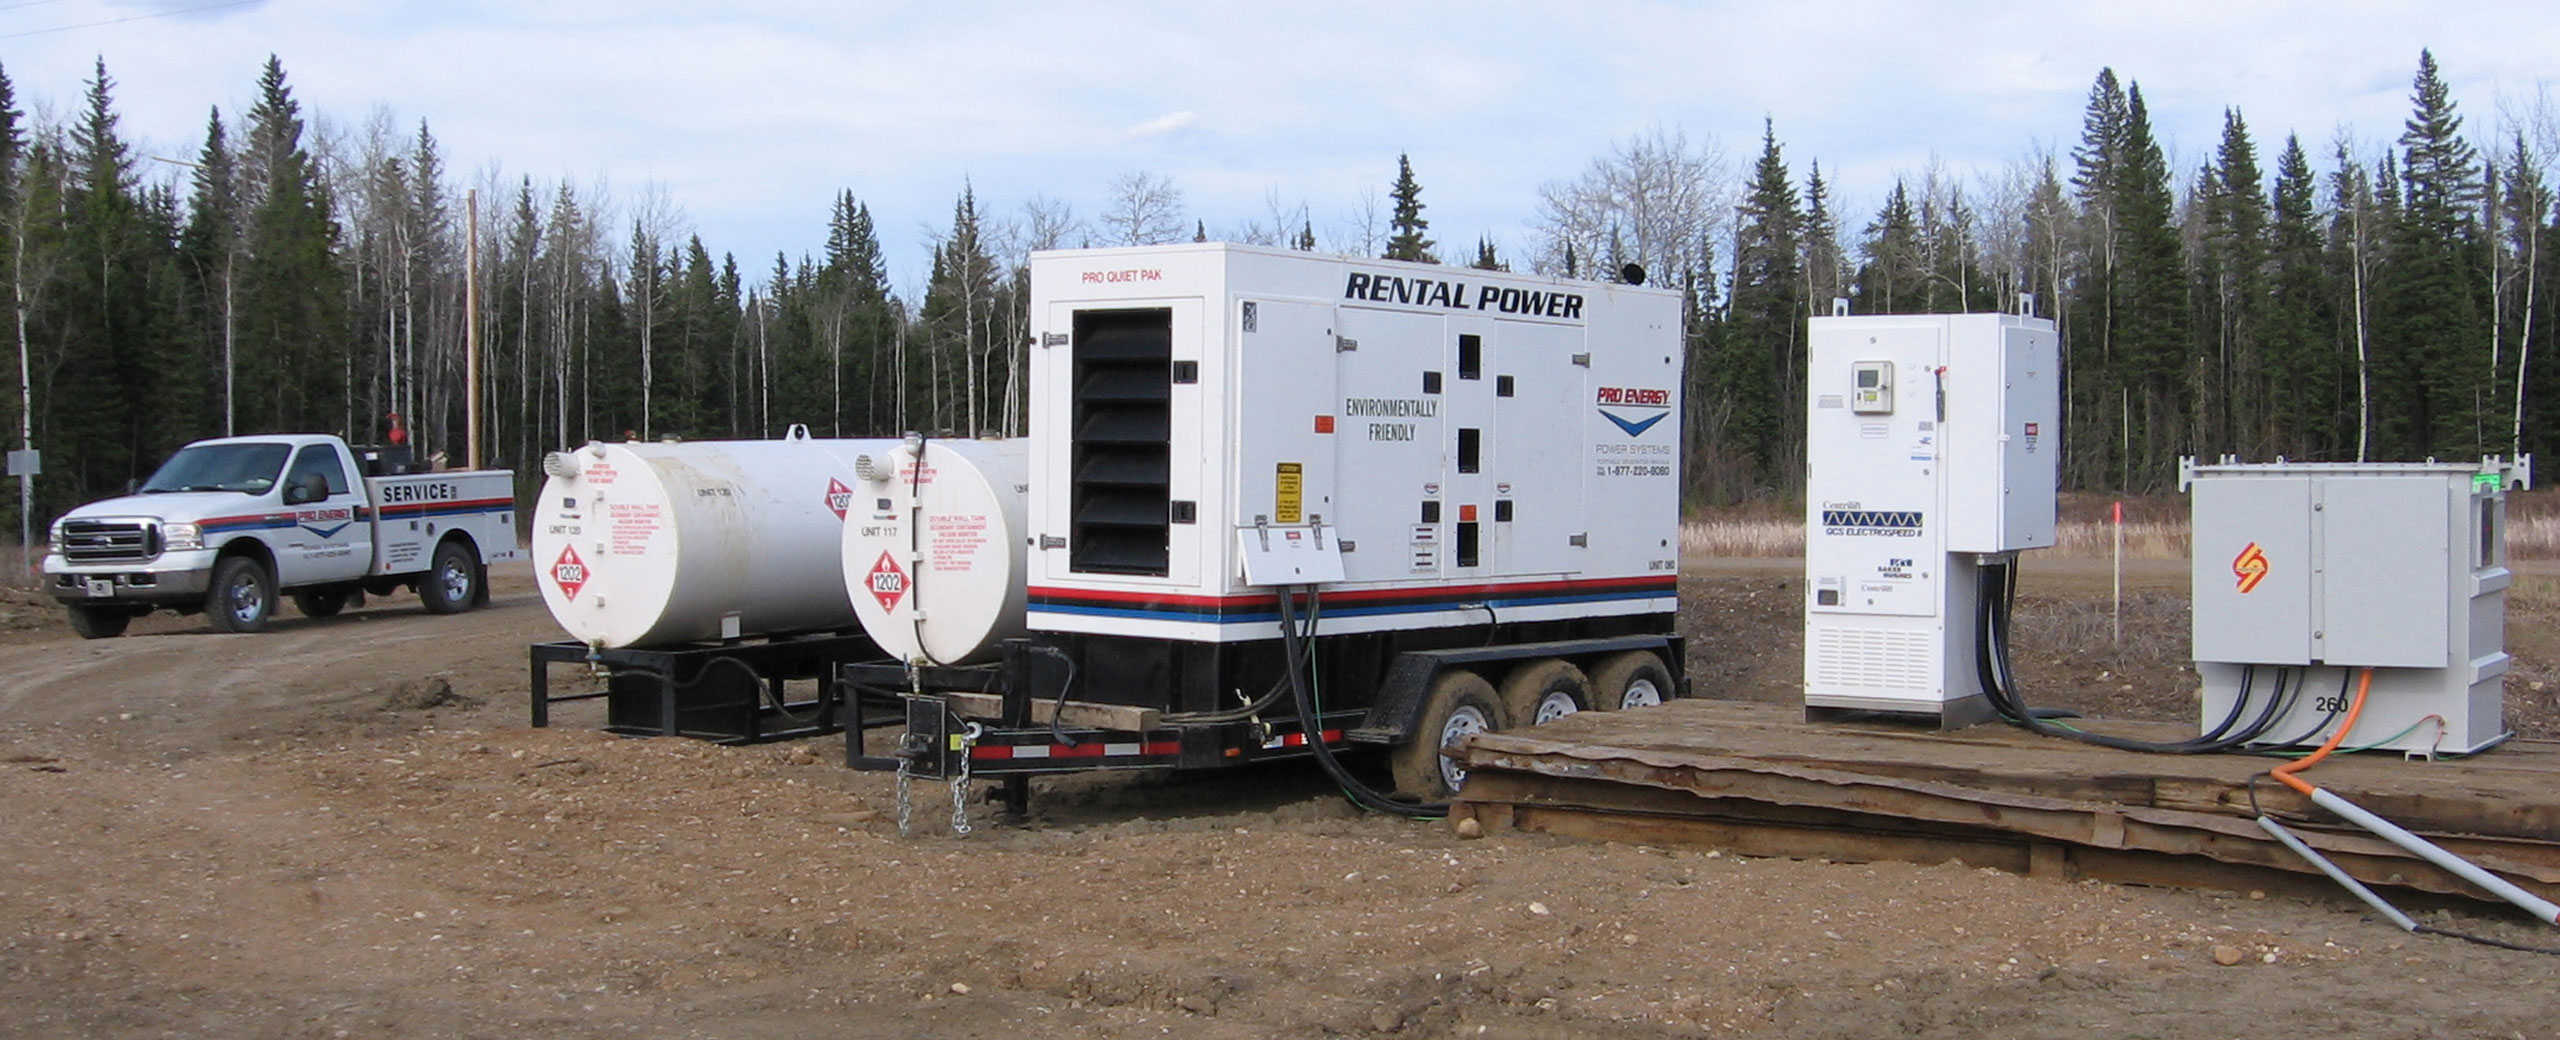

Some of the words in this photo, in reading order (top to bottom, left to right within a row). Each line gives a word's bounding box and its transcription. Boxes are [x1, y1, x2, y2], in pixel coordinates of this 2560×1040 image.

[1082, 272, 1104, 284] PRO
[1106, 270, 1138, 283] QUIET
[1140, 268, 1162, 281] PAK
[1345, 271, 1470, 310] RENTAL
[1477, 285, 1584, 319] POWER
[1596, 387, 1623, 403] PRO
[1624, 388, 1671, 405] ENERGY
[1346, 397, 1438, 418] ENVIRONMENTALLY
[1368, 422, 1416, 442] FRIENDLY
[1596, 443, 1628, 455] POWER
[1629, 444, 1671, 456] SYSTEMS
[383, 483, 449, 503] SERVICE
[549, 525, 566, 535] UNIT
[861, 527, 881, 537] UNIT
[883, 526, 898, 537] 117
[558, 566, 581, 582] 1202
[874, 573, 901, 591] 1202
[567, 587, 574, 597] 3
[884, 598, 892, 609] 3
[2315, 696, 2349, 713] 260
